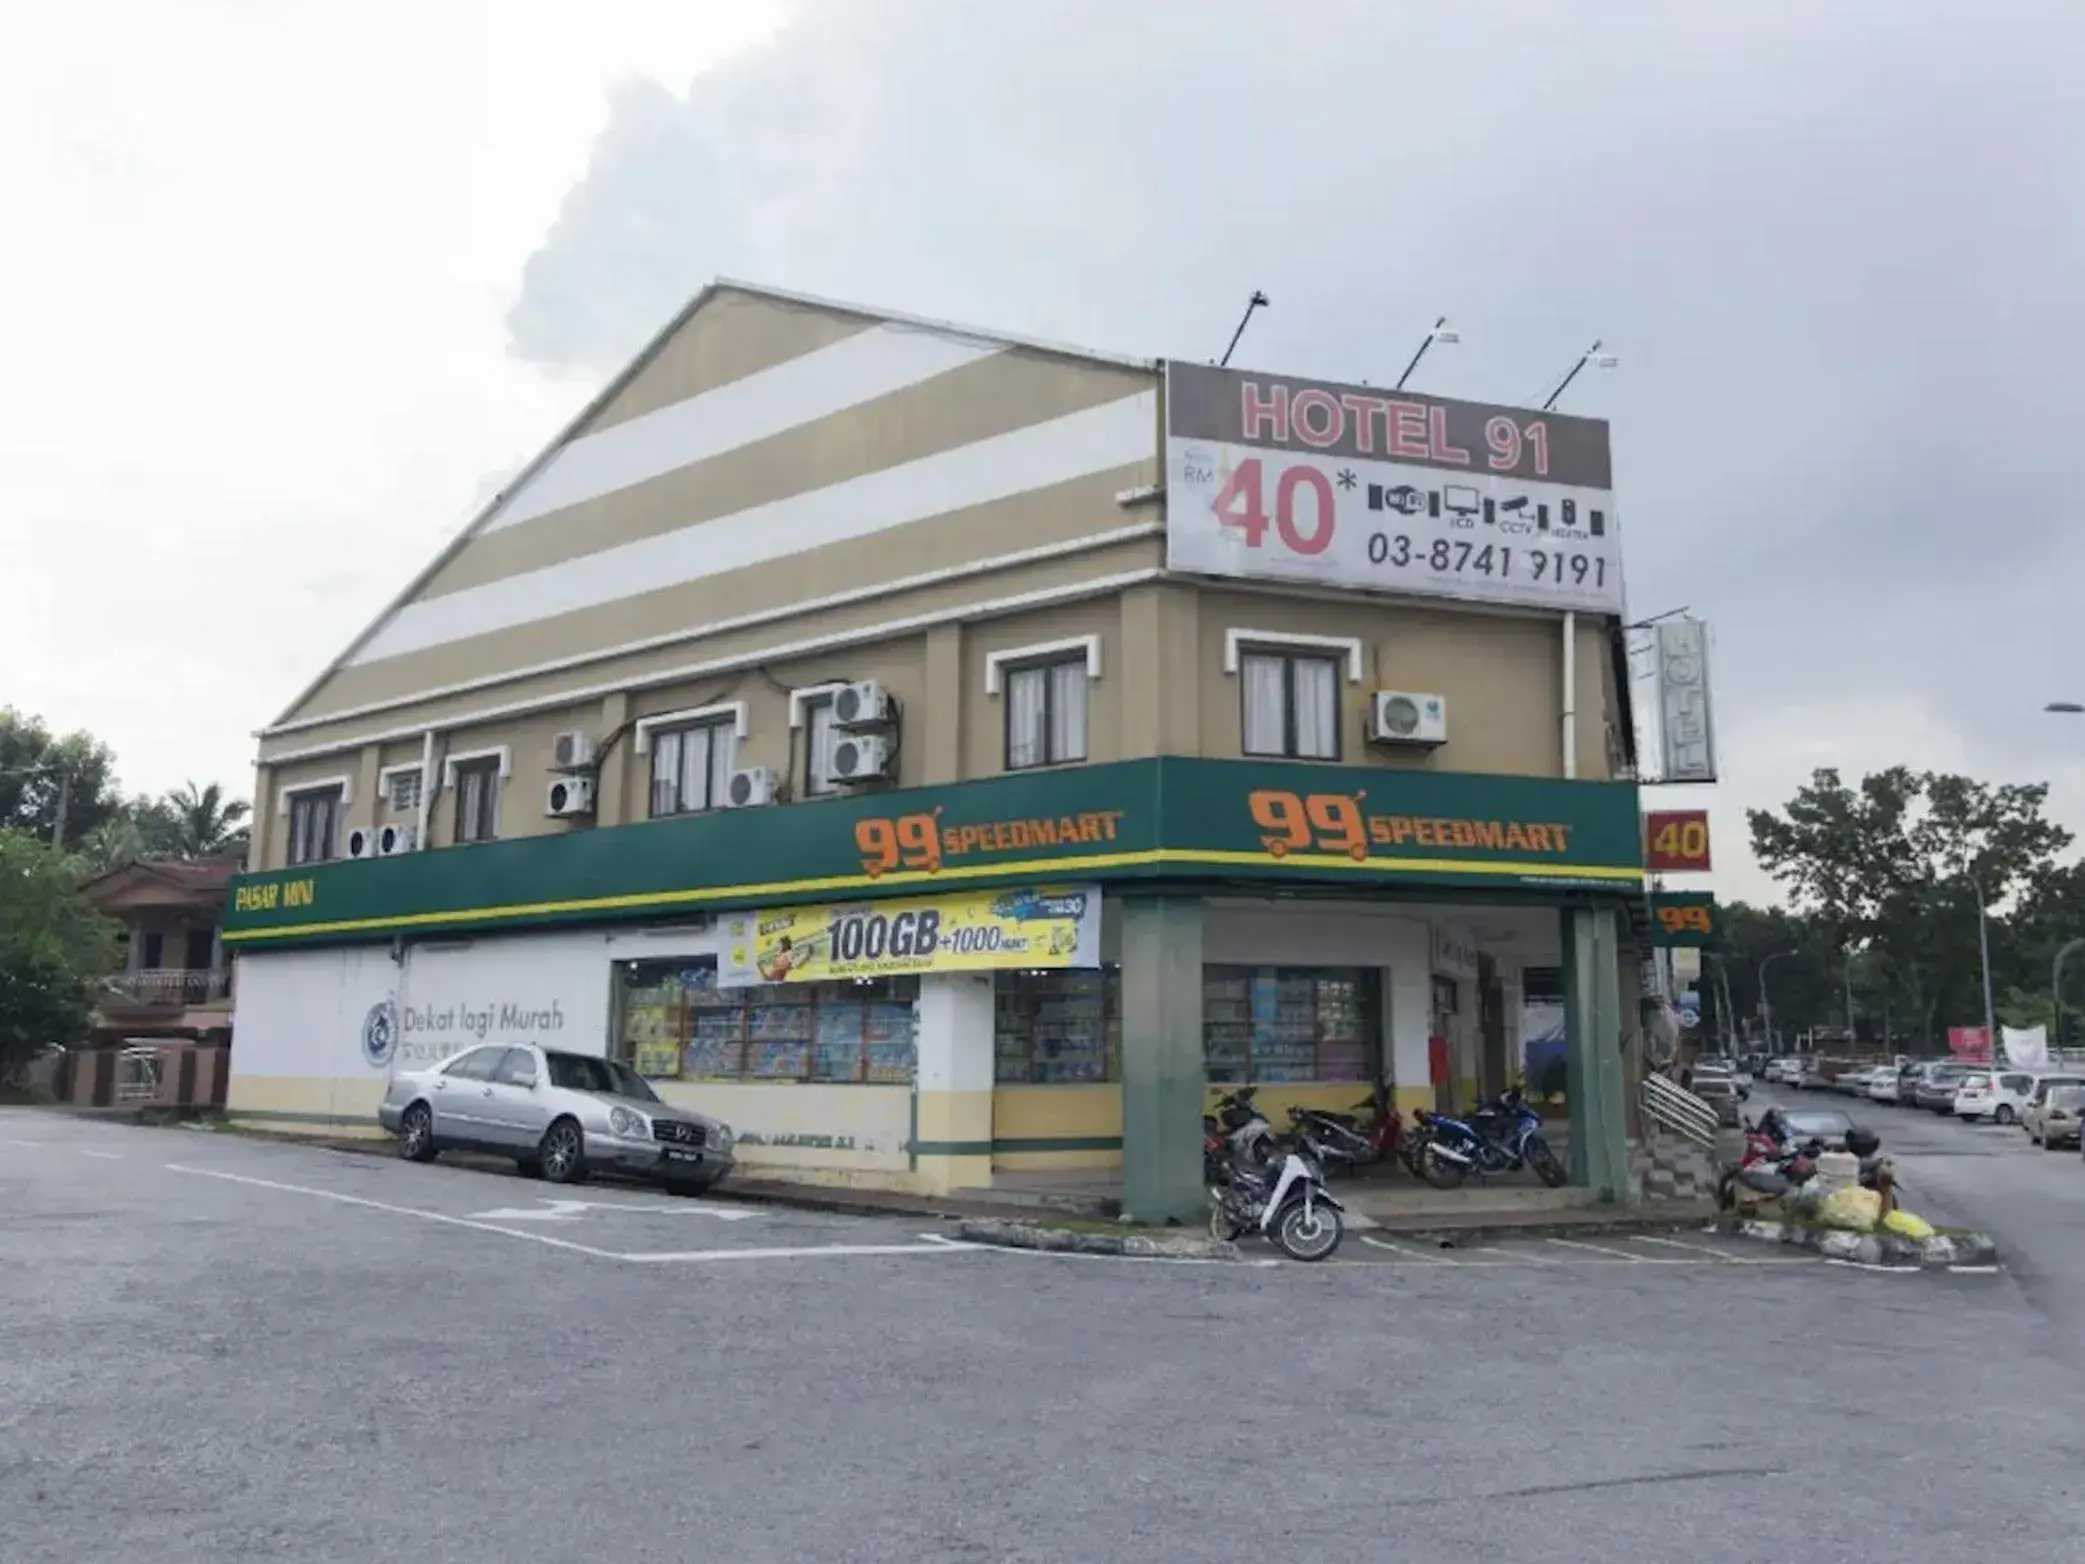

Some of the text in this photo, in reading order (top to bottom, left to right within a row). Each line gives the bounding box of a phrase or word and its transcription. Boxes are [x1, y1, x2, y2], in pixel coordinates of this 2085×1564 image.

[1241, 381, 1548, 476] HOTEL 91
[1368, 532, 1511, 578] 03-8741
[1532, 549, 1606, 588] 9191
[855, 806, 1121, 880] 99 SPEEDMART
[1248, 789, 1571, 861] 99 SPEEDMART
[1653, 820, 1708, 858] 40
[235, 883, 280, 912] PASAR
[1656, 906, 1712, 934] 99
[827, 910, 940, 961] 100GB
[404, 1000, 564, 1038] Dekat lagi Murah
